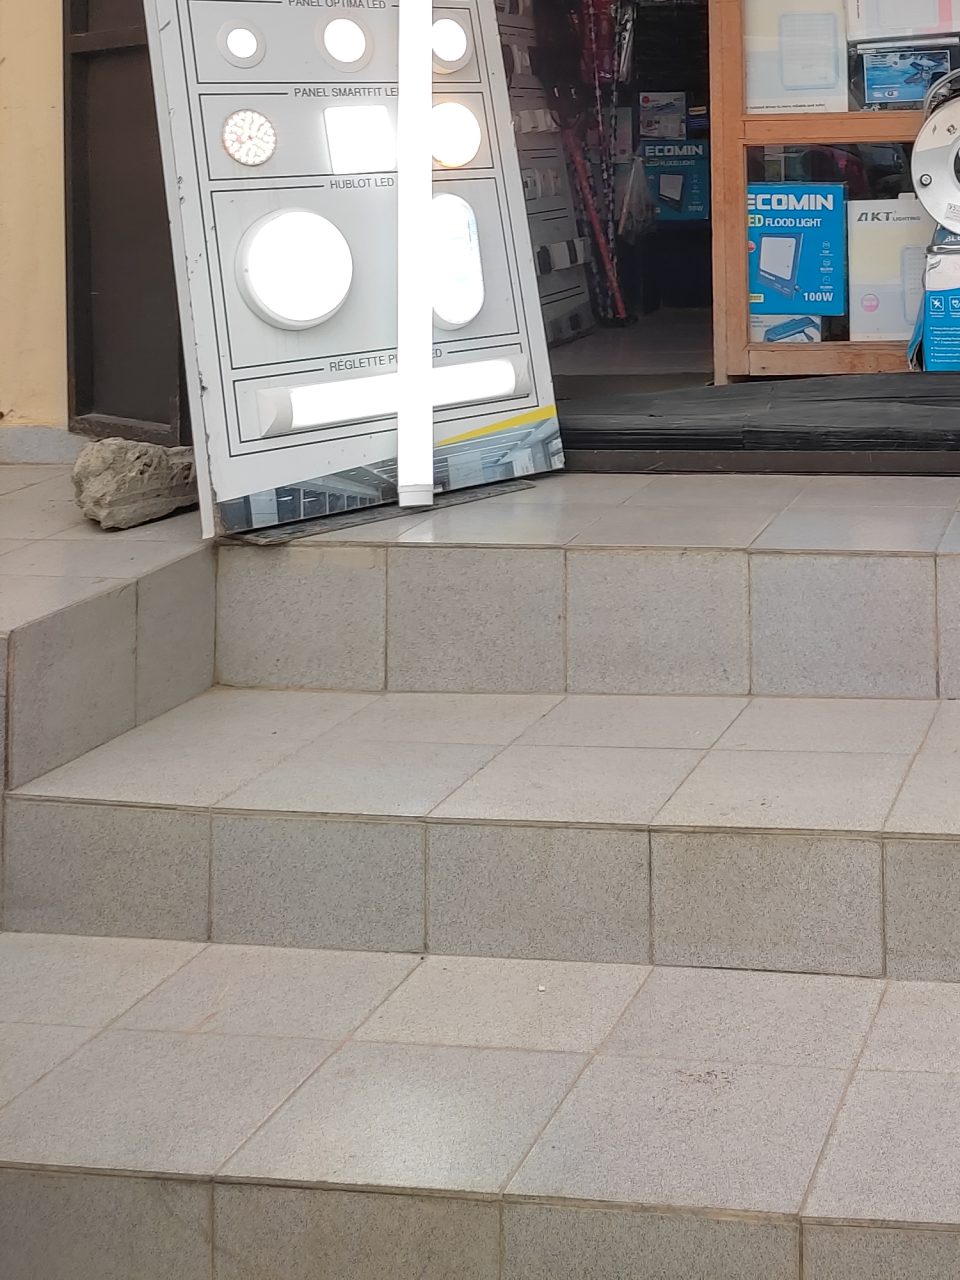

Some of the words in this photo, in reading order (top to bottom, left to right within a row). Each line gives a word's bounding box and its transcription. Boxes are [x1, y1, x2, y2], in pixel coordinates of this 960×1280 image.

[366, 0, 387, 9] LED
[293, 87, 330, 97] PANEL
[331, 87, 382, 98] SMARTFIT
[385, 87, 399, 97] LE
[329, 178, 372, 189] HUBLOT
[374, 177, 395, 188] LED
[747, 193, 834, 211] ECOMIN
[748, 214, 765, 227] ED
[765, 218, 795, 228] FLOOD
[796, 218, 823, 228] LIGHT
[856, 211, 893, 222] AKT
[803, 292, 834, 302] 100W
[328, 355, 386, 372] RÉGLETTE
